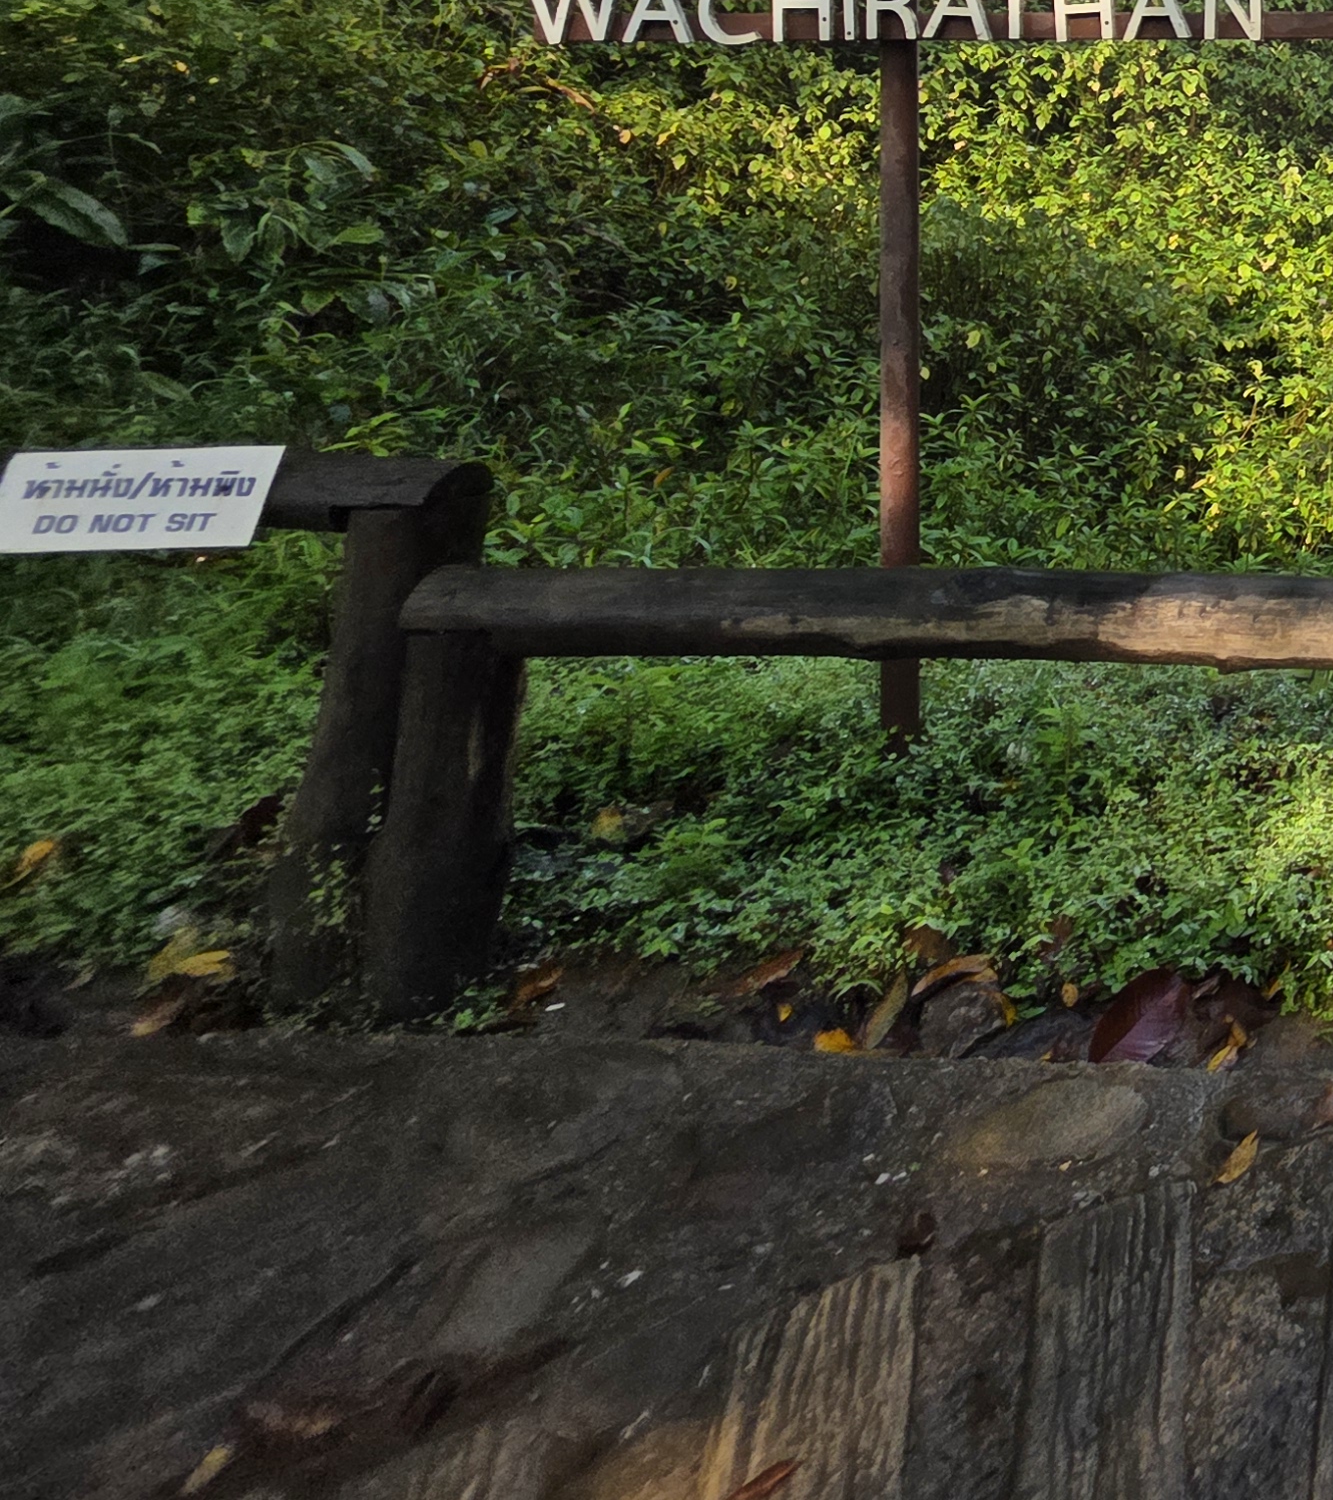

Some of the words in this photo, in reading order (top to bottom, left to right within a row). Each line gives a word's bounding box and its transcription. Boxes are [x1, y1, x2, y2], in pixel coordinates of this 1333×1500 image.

[31, 515, 79, 535] DO
[87, 513, 156, 534] NOT
[165, 512, 217, 533] SIT
